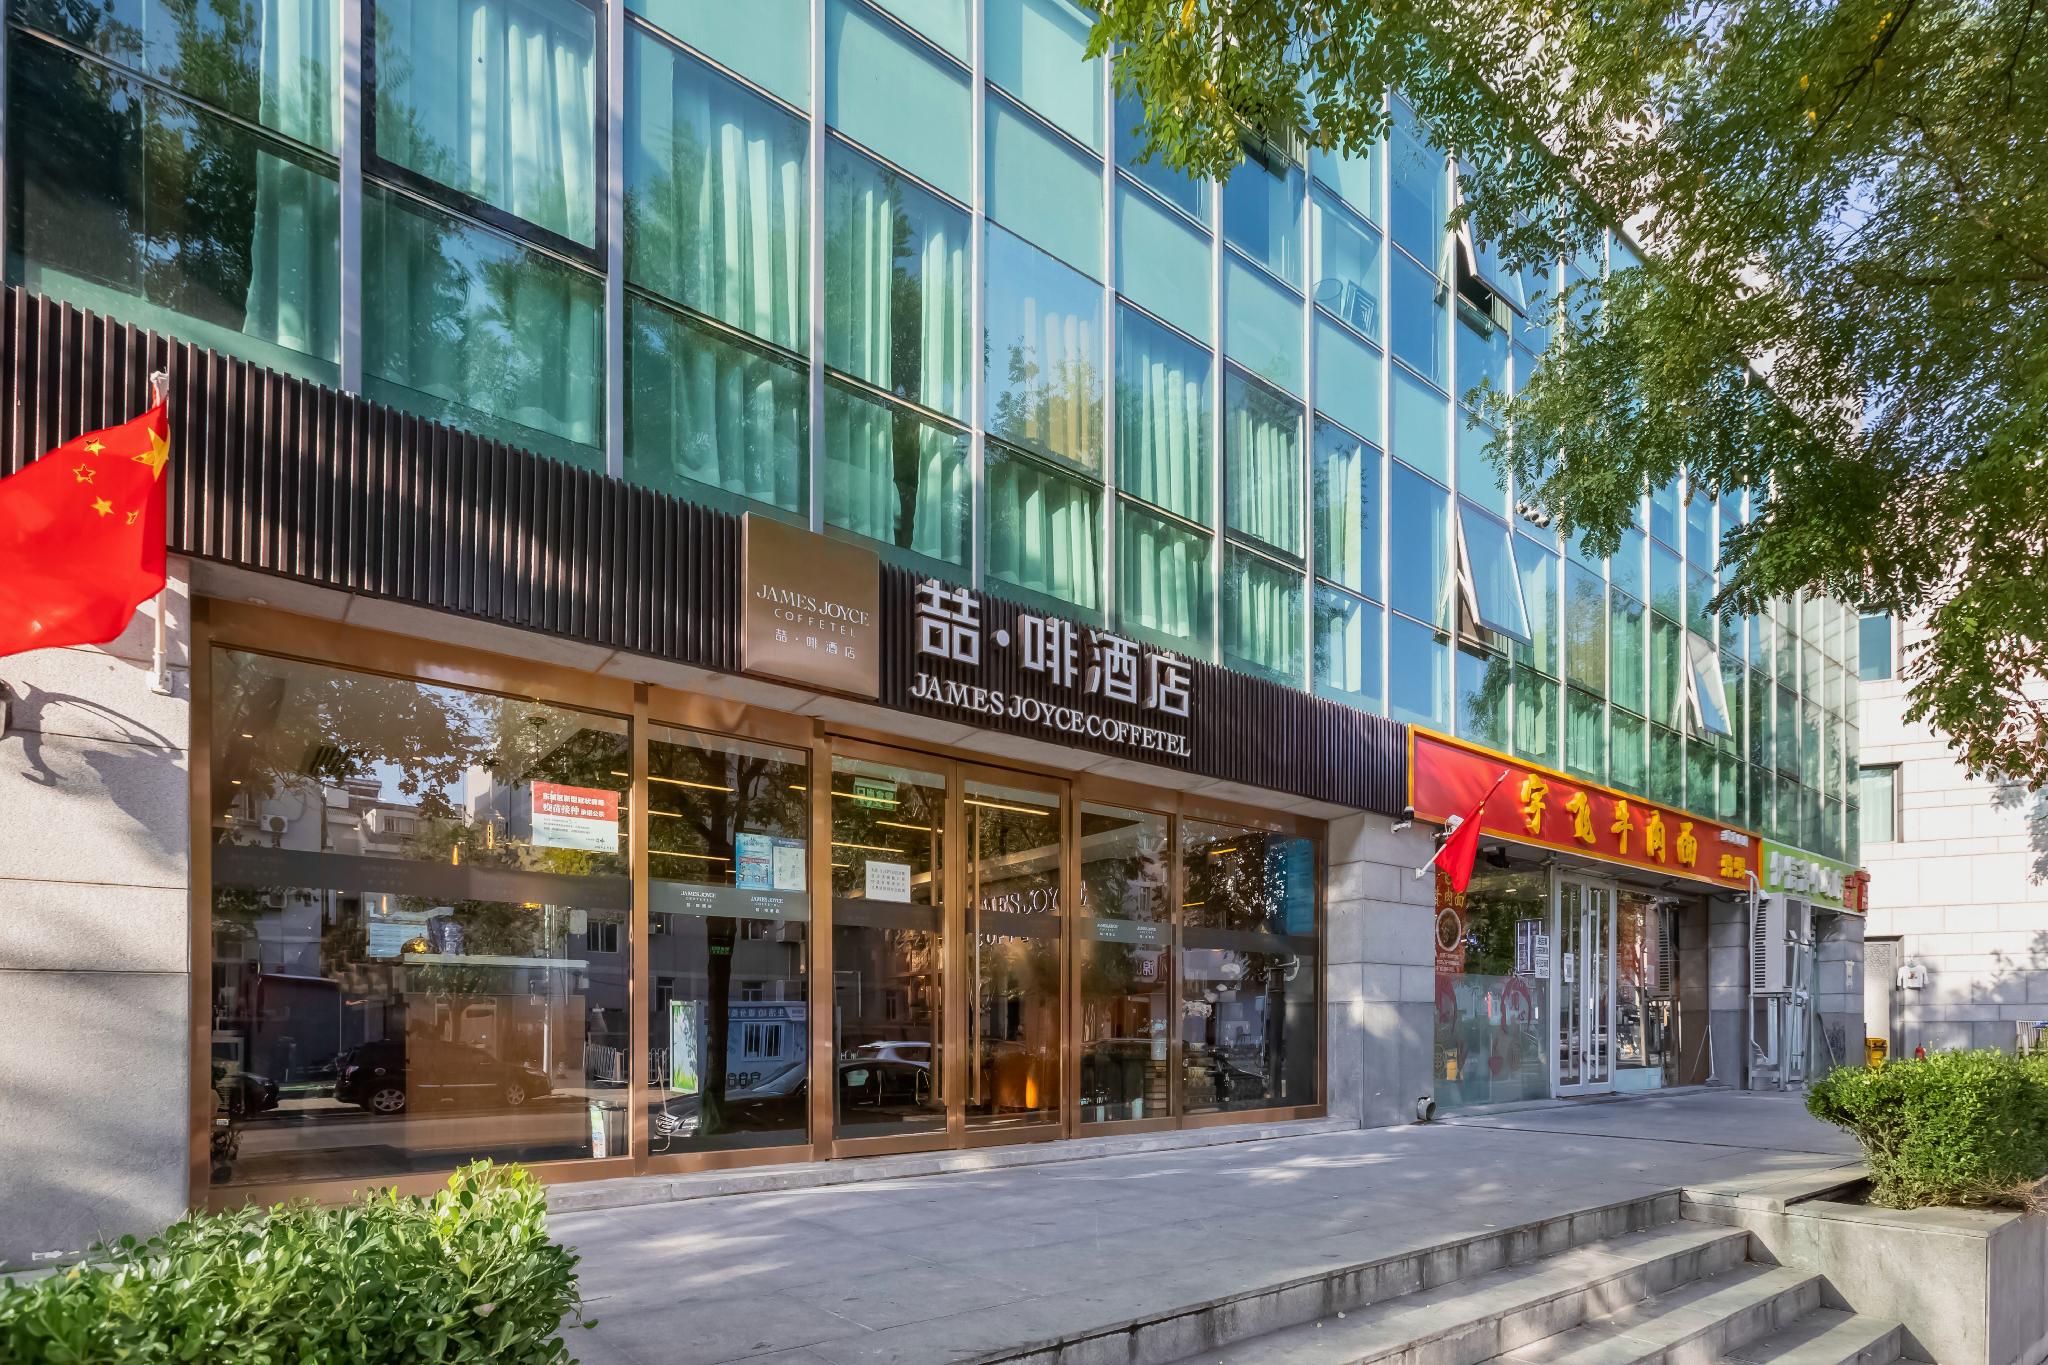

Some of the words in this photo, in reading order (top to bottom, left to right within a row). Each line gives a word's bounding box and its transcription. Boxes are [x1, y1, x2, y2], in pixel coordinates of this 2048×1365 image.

[756, 584, 817, 612] JAMES
[819, 601, 869, 626] JOYCE
[774, 608, 855, 637] COFFETEL
[916, 579, 1192, 718] 喆·啡酒店
[911, 673, 1004, 716] JAMES
